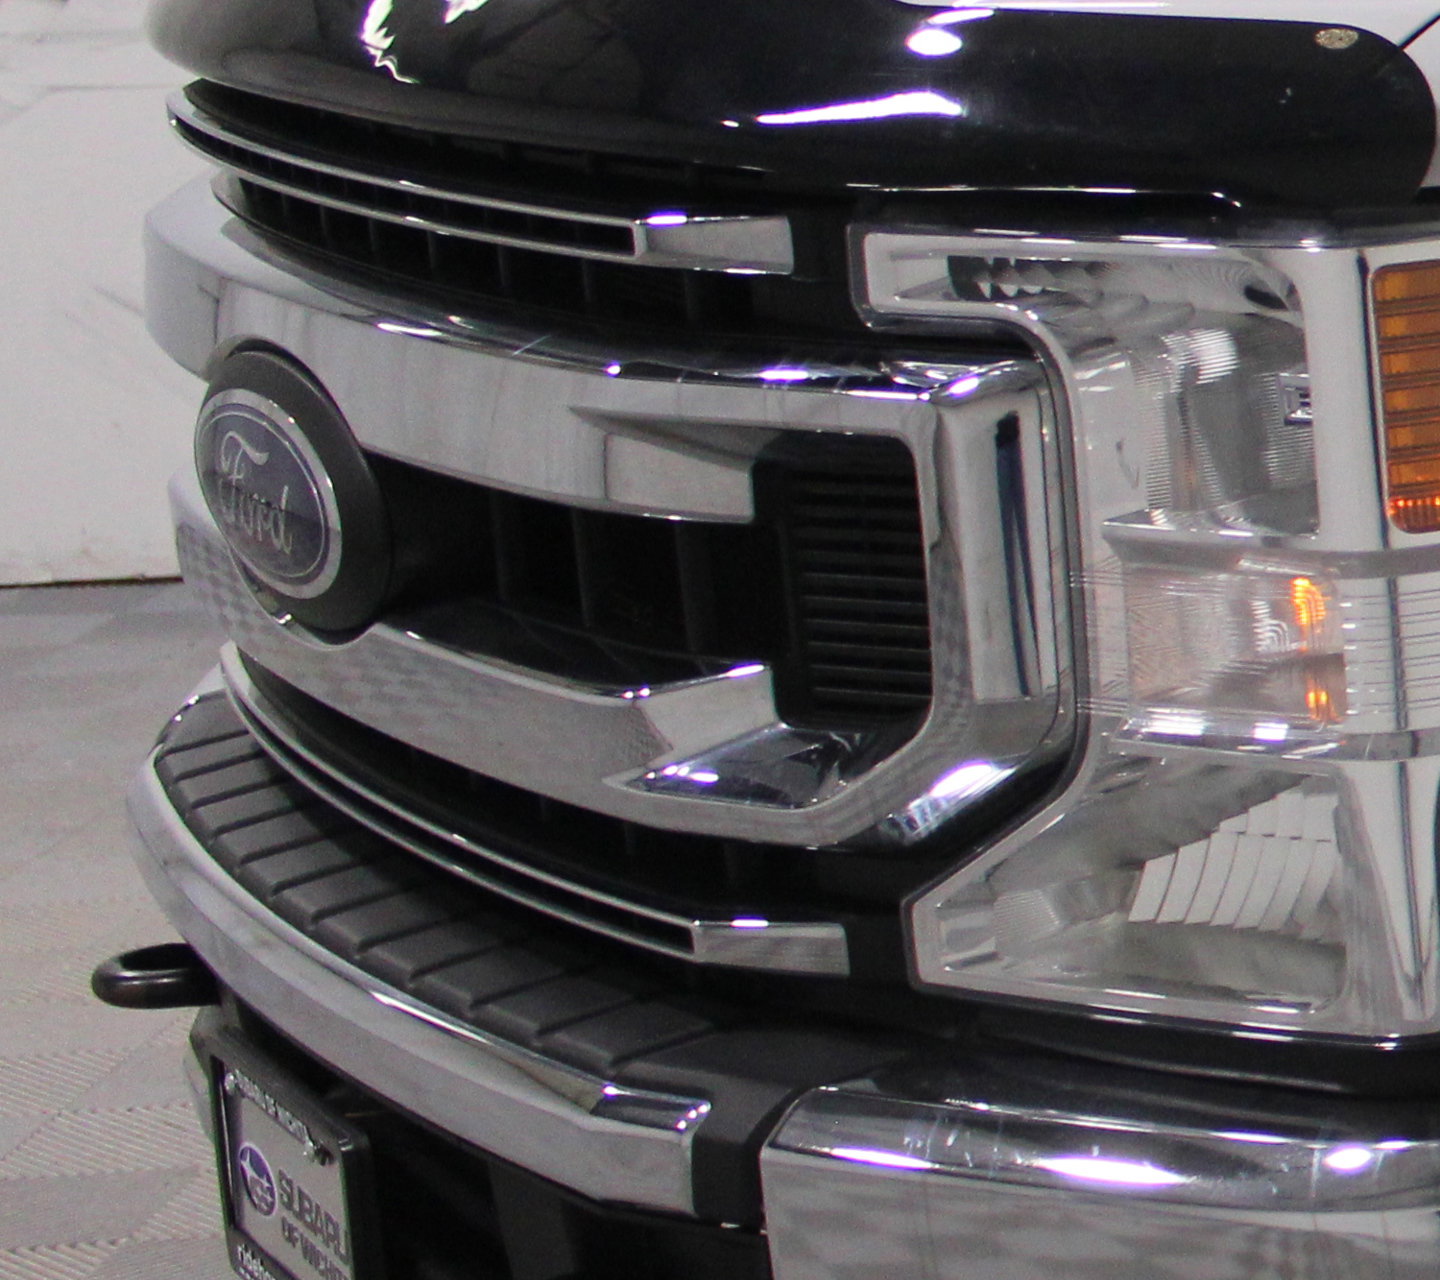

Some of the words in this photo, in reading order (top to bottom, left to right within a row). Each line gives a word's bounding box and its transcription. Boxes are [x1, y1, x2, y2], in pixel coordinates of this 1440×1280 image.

[219, 430, 294, 556] Ford
[279, 1169, 350, 1265] SUBARU
[282, 1216, 299, 1248] OF
